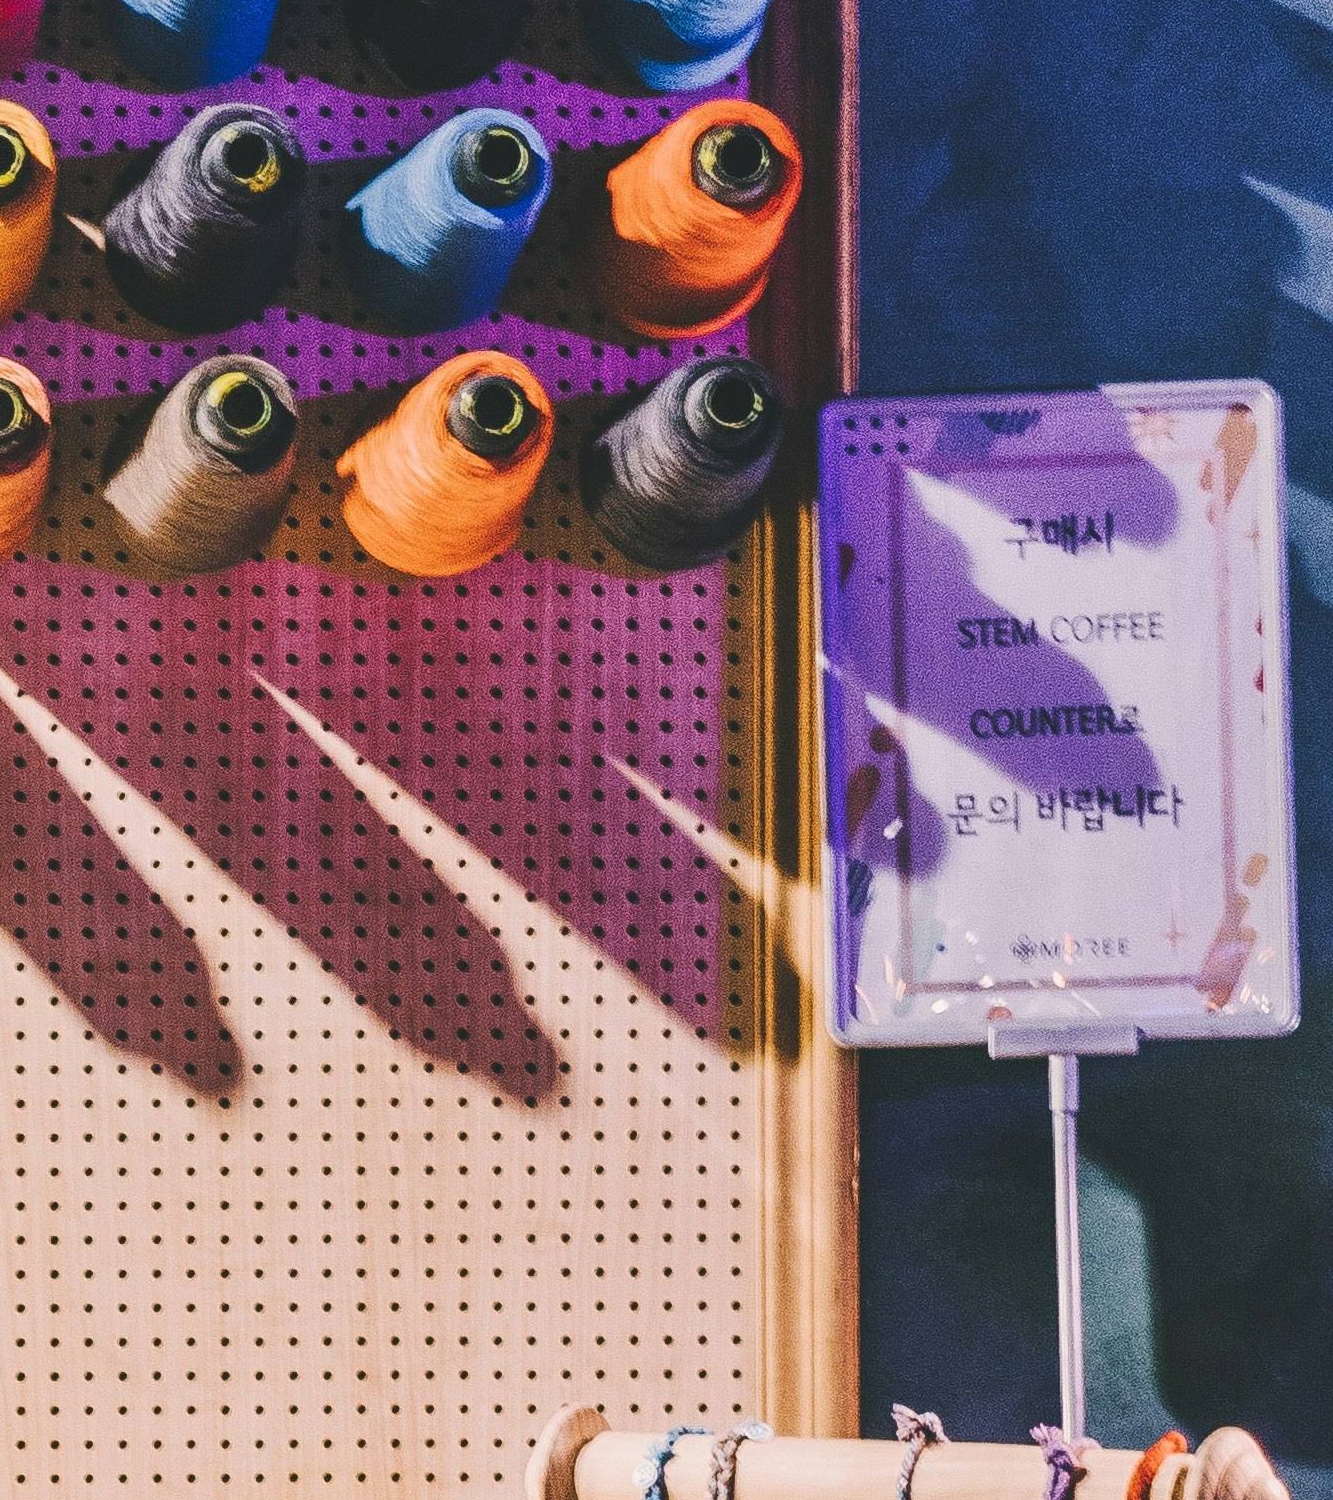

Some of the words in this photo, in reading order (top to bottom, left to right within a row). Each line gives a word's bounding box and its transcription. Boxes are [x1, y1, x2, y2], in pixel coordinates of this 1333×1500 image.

[1004, 510, 1115, 560] 구매시
[957, 616, 1039, 651] STEM
[1050, 611, 1164, 644] COFFEE
[947, 790, 1021, 836] 문의
[1035, 783, 1184, 832] 바랍니다
